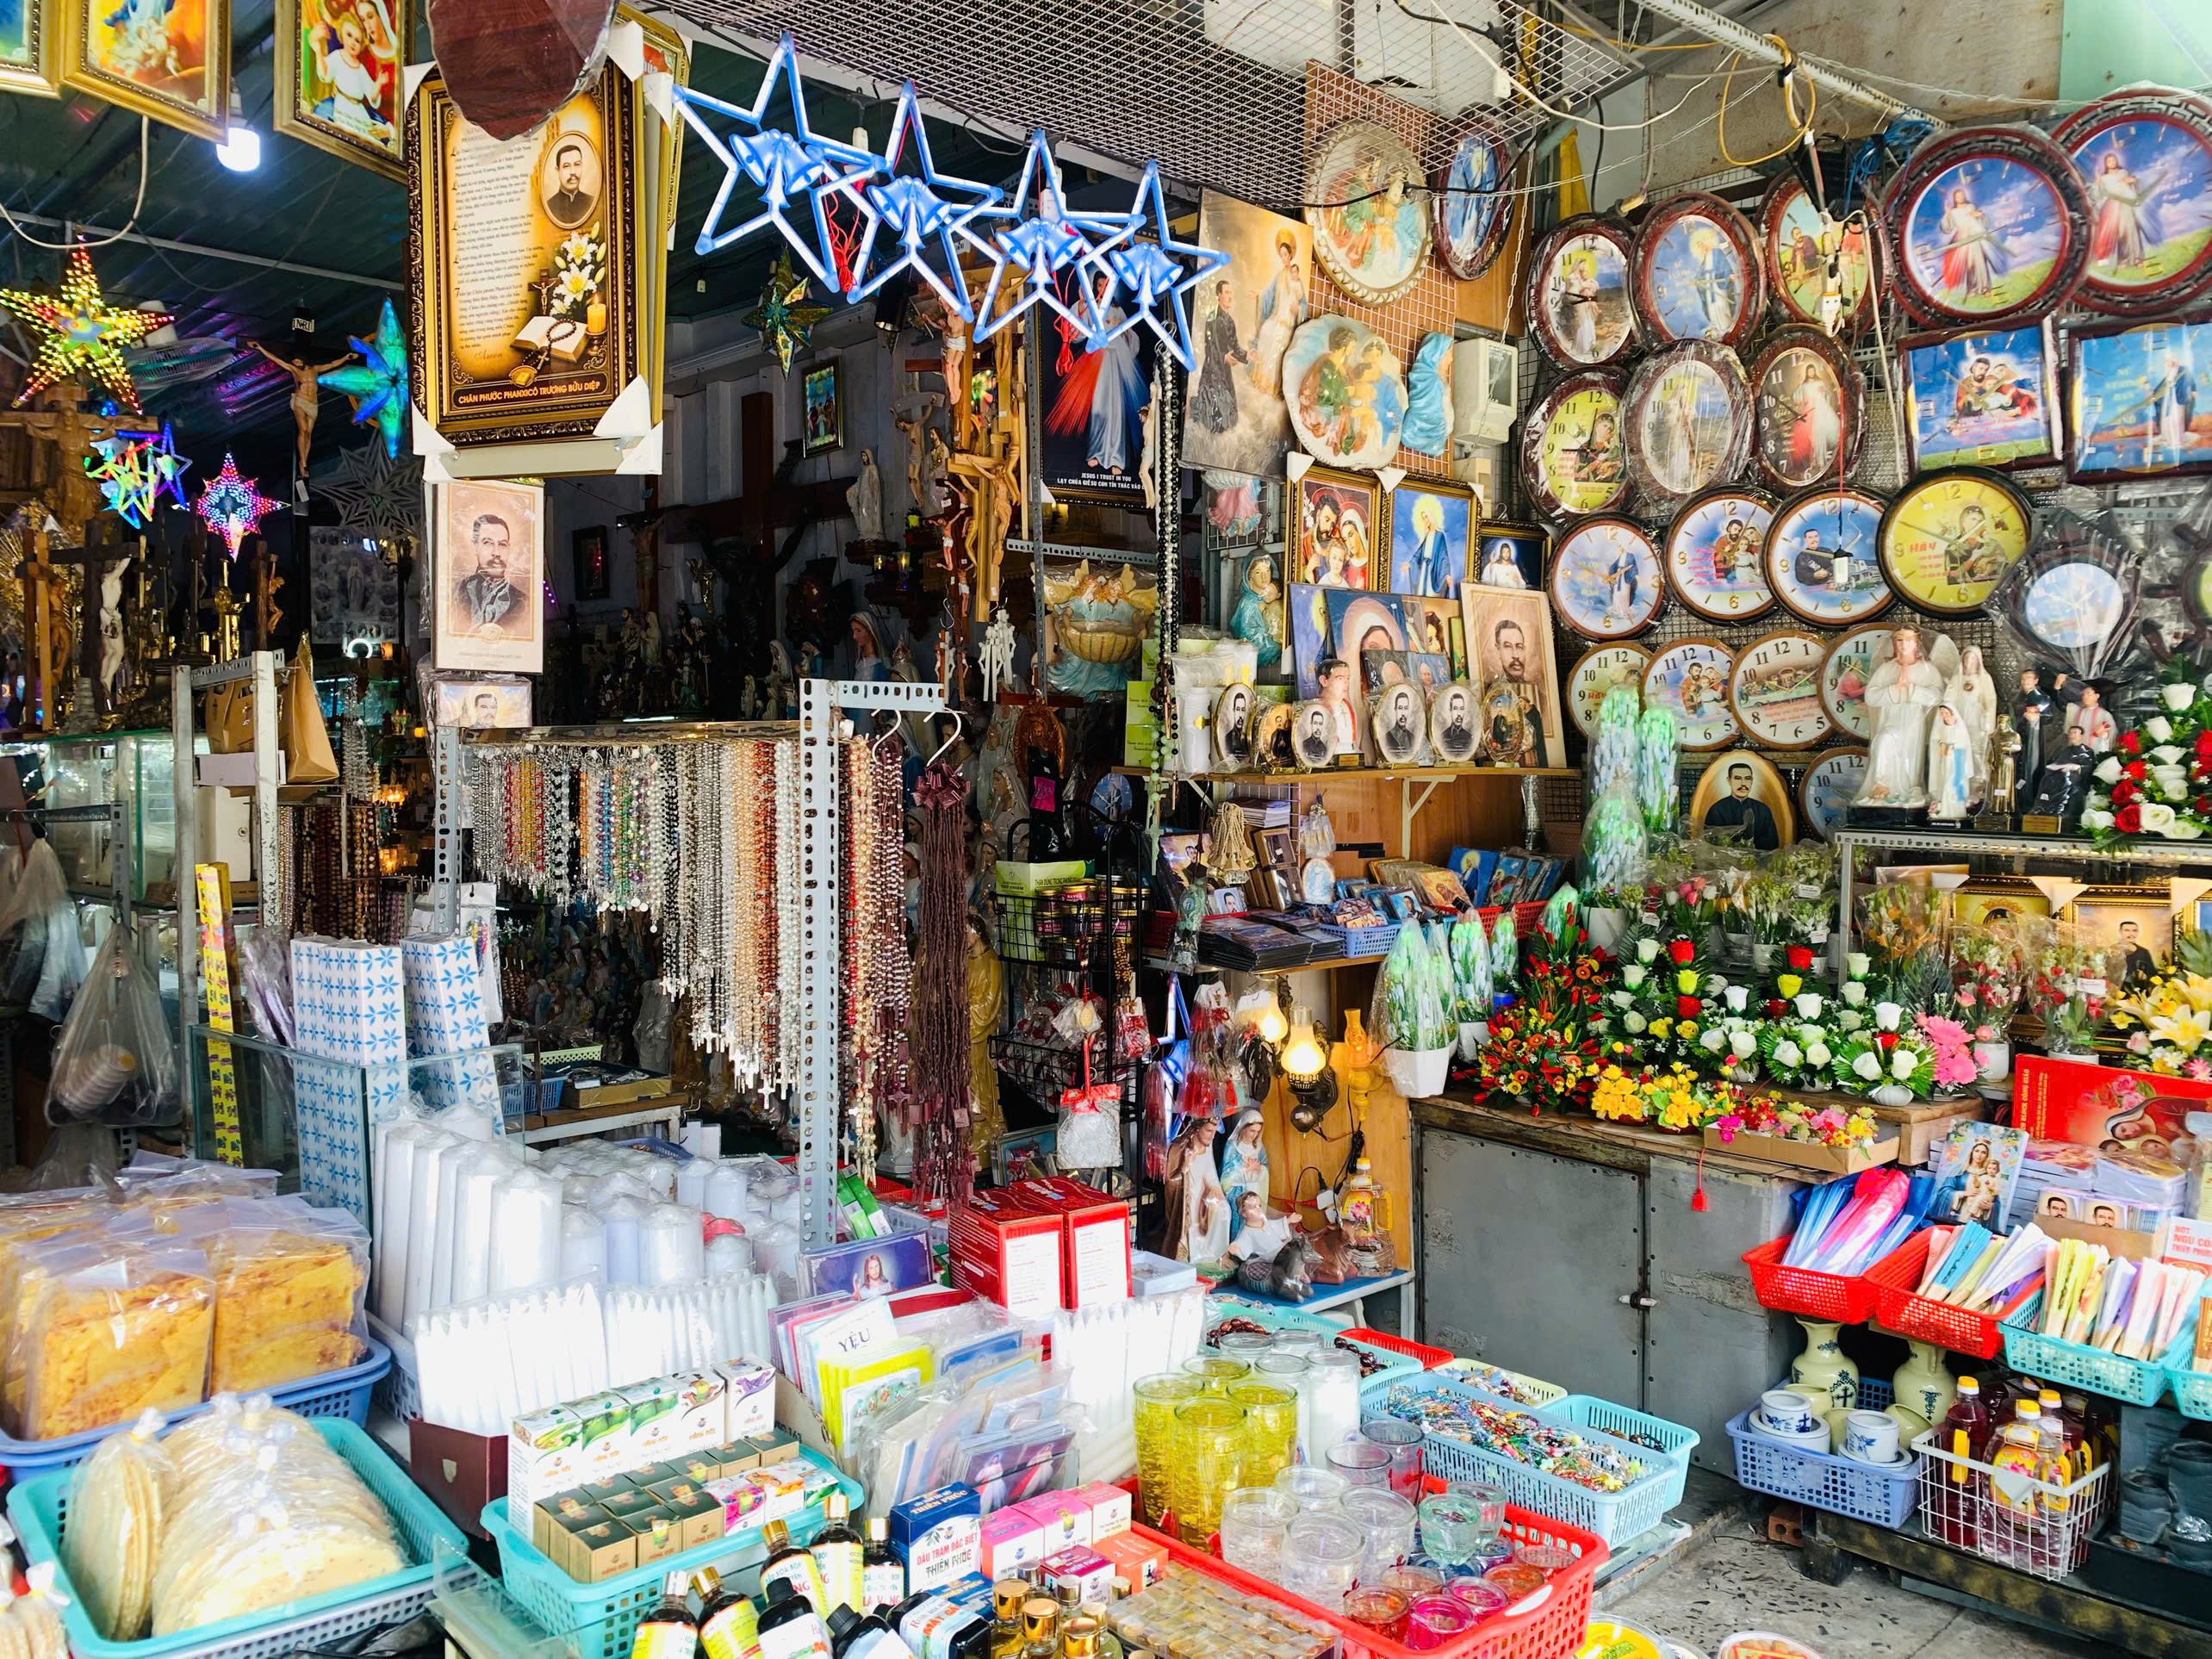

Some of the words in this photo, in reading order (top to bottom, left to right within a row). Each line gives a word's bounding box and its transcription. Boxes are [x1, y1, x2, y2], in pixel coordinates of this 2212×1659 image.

[1791, 354, 1805, 368] 12
[1771, 371, 1784, 384] 11
[458, 393, 478, 404] CHÂN
[479, 390, 503, 402] PHƯỚC
[503, 386, 539, 399] PHANXICÔ
[539, 383, 568, 395] TRƯƠNG
[569, 381, 584, 392] BỬU
[585, 381, 600, 392] DIỆP
[1588, 391, 1602, 403] 12
[1565, 403, 1576, 413] 11
[1762, 395, 1777, 409] 10
[1553, 423, 1565, 434] 10
[1762, 417, 1770, 431] 9
[1547, 443, 1555, 455] 9
[1767, 439, 1776, 454] 8
[1779, 460, 1787, 474] 7
[1804, 468, 1812, 481] 6
[1117, 481, 1131, 489] THÁC
[1558, 485, 1566, 497] 7
[1943, 483, 1961, 500] 12
[1606, 487, 1613, 499] 5
[1581, 498, 1588, 509] 6
[1722, 501, 1737, 517] 12
[1894, 543, 1904, 557] 9
[1678, 551, 1687, 565] 9
[1730, 595, 1739, 609] 6
[1774, 641, 1790, 656] 12
[1854, 641, 1867, 654] 11
[1614, 650, 1629, 662] 12
[1681, 647, 1697, 662] 12
[1755, 651, 1769, 665] 11
[1598, 657, 1608, 668] 11
[1664, 657, 1677, 671] 11
[1837, 655, 1851, 668] 10
[1584, 669, 1596, 681] 10
[1743, 668, 1757, 681] 10
[1830, 678, 1838, 690] 9
[1578, 690, 1586, 702] 9
[1836, 700, 1845, 713] 8
[1584, 710, 1592, 721] 8
[1751, 711, 1761, 724] 8
[1724, 719, 1732, 731] 5
[1816, 716, 1825, 730] 5
[1852, 717, 1861, 730] 7
[1680, 726, 1687, 738] 7
[1704, 728, 1712, 741] 6
[1769, 724, 1777, 736] 7
[1828, 761, 1843, 774] 11
[1847, 755, 1864, 768] 12
[1816, 775, 1830, 787] 10
[1814, 797, 1823, 809] 9
[910, 1500, 942, 1514] THIÊN
[776, 1566, 789, 1576] XOA
[926, 1557, 949, 1579] THIÊN
[877, 1595, 901, 1606] VNG
